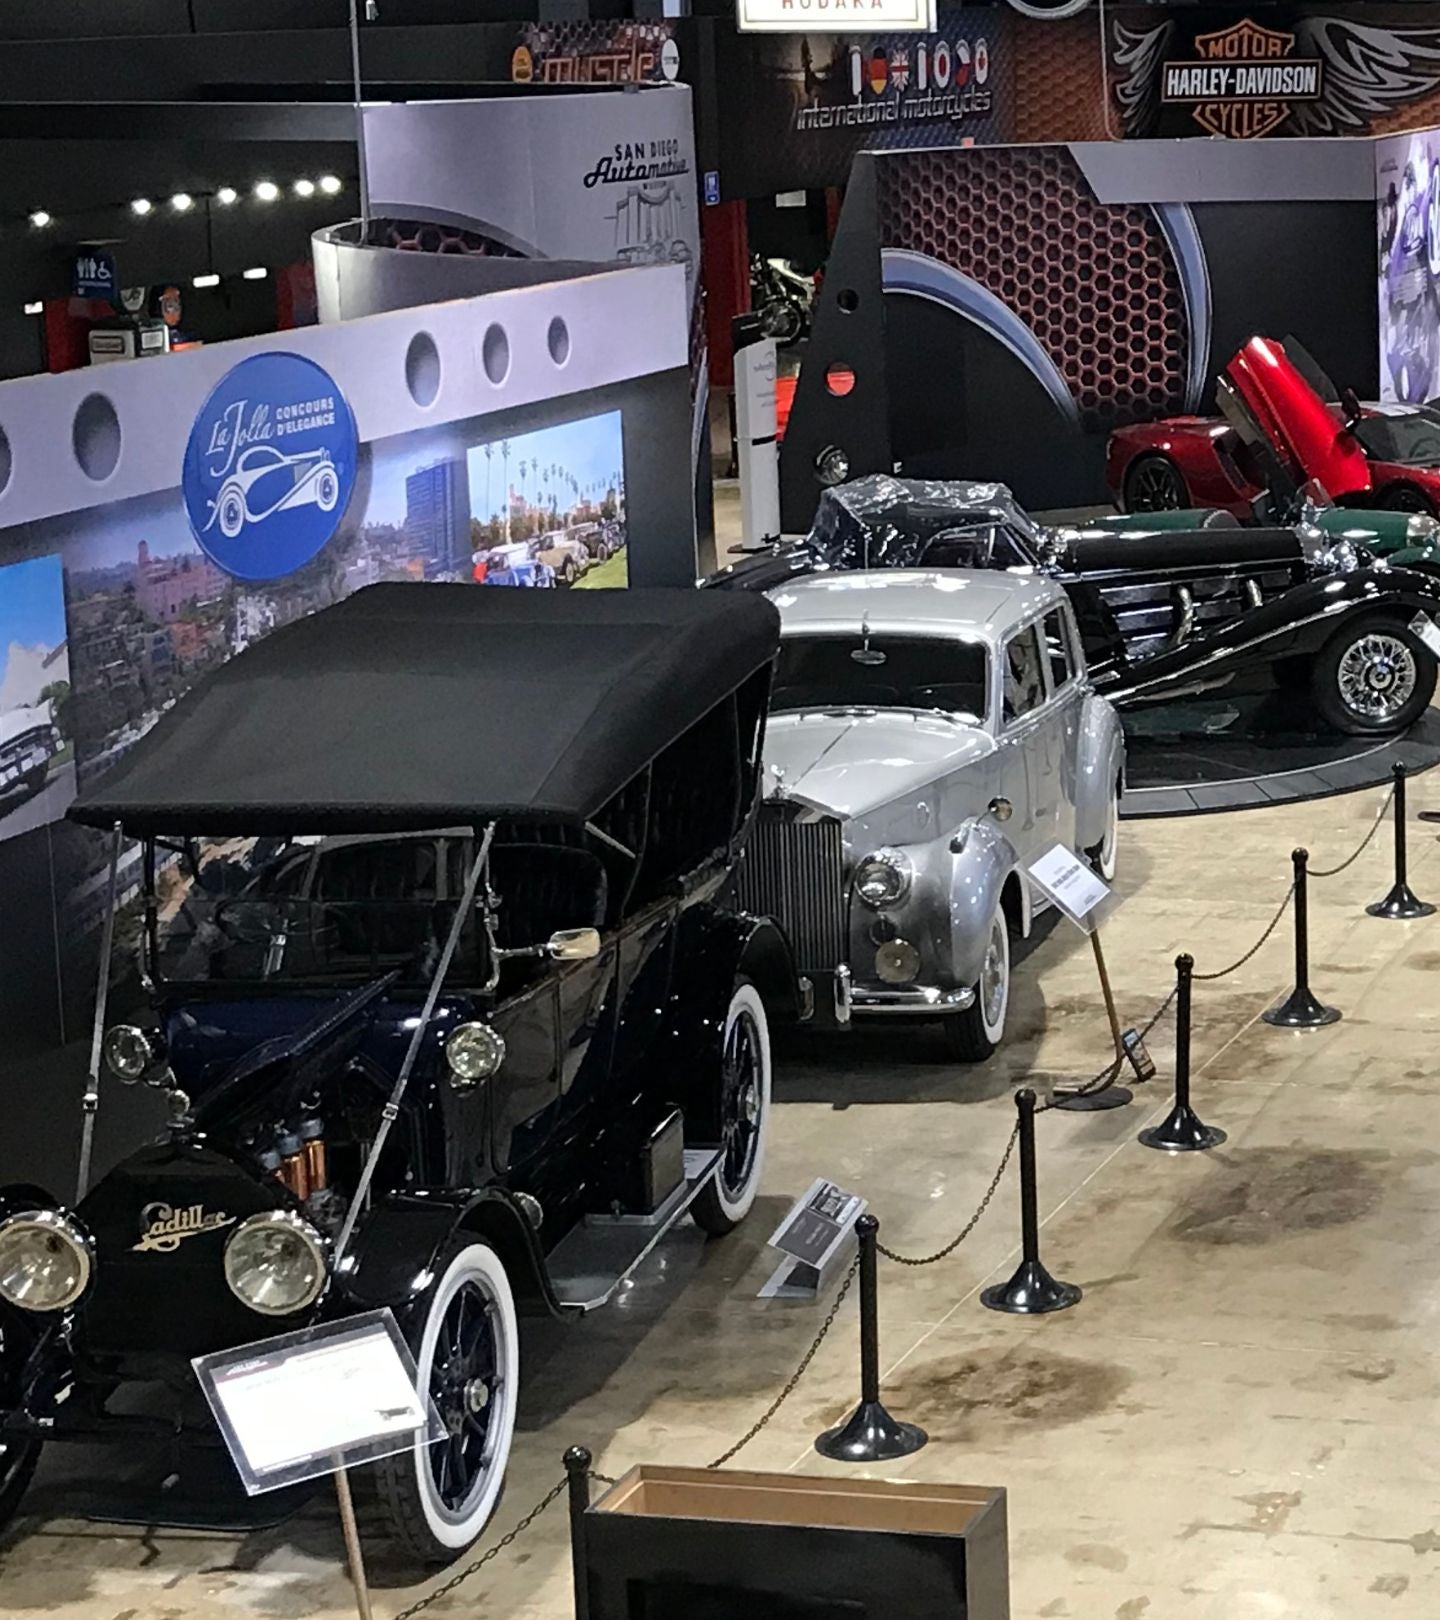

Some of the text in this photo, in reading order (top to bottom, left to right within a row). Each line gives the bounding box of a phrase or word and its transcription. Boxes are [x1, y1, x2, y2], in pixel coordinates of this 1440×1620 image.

[1208, 26, 1283, 58] MOTOR
[1166, 66, 1316, 96] HARLEY-DAVIDSON
[797, 84, 991, 130] international motorcycles
[1204, 102, 1278, 137] CYCLES
[615, 143, 645, 161] SAN
[276, 396, 334, 420] CONCOURS
[205, 399, 274, 478] La Jolla
[134, 1202, 237, 1252] Cadillac
